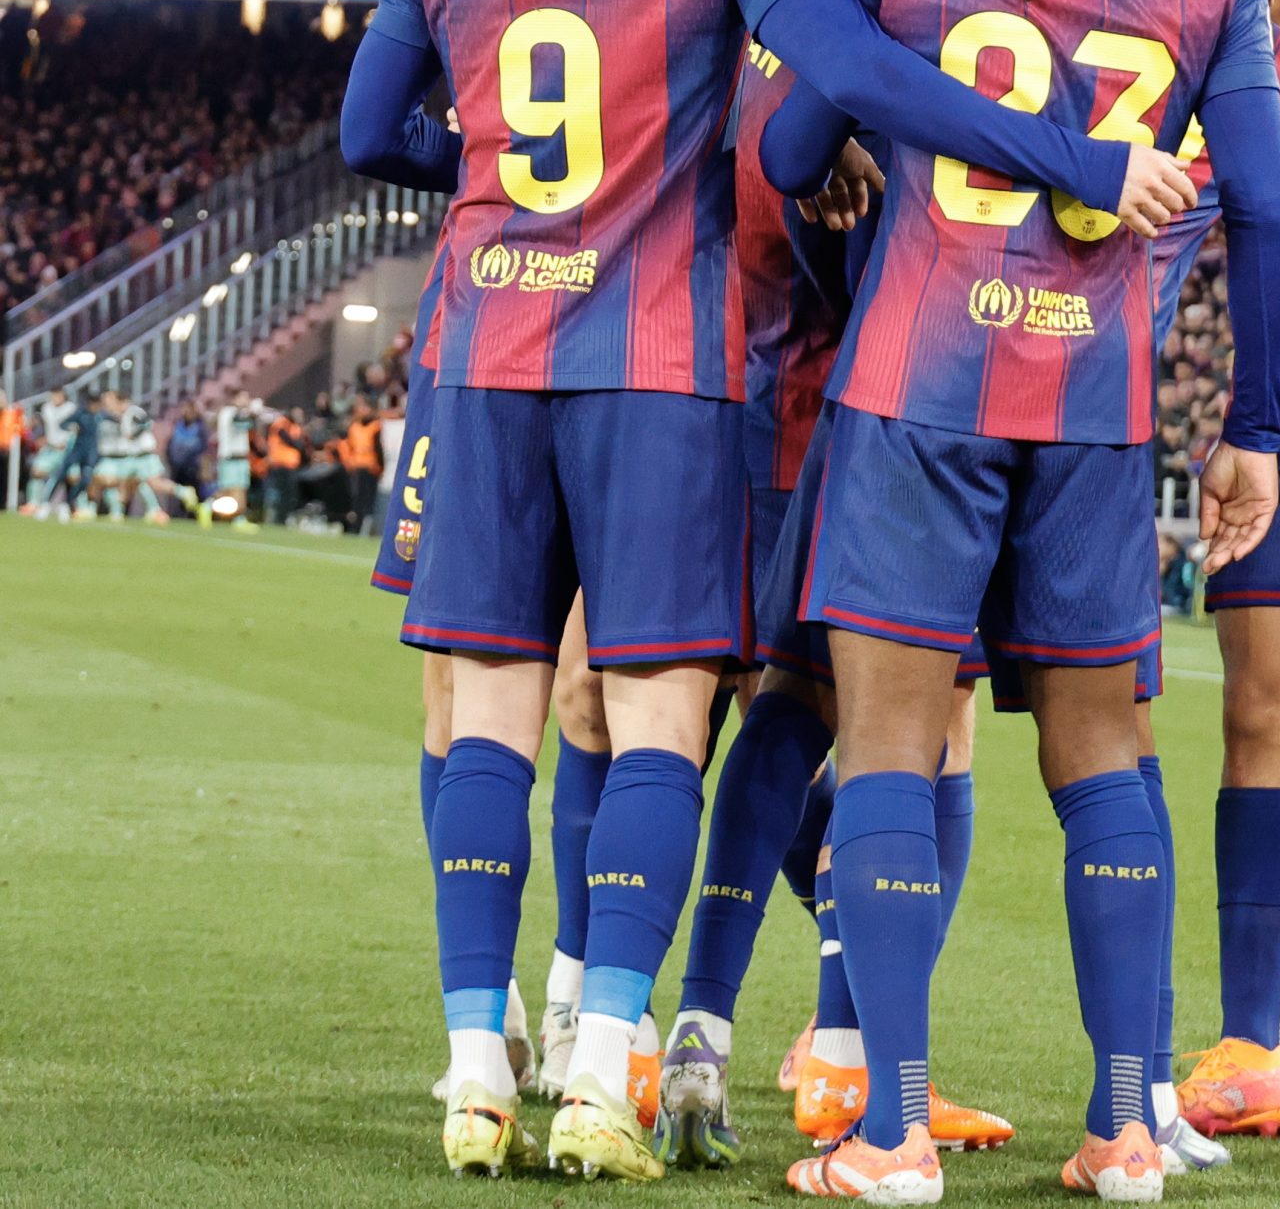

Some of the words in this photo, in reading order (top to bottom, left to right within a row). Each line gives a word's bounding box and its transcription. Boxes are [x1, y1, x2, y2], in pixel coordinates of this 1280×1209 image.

[498, 7, 605, 214] 9
[932, 10, 1177, 242] 23
[525, 250, 598, 271] UNHCR
[519, 266, 595, 285] ACNUR
[1028, 286, 1089, 313] UNHCR
[1023, 306, 1093, 329] ACNUR
[443, 858, 511, 876] BARÇA
[1083, 863, 1158, 881] BARÇA
[875, 878, 940, 895] BARÇA
